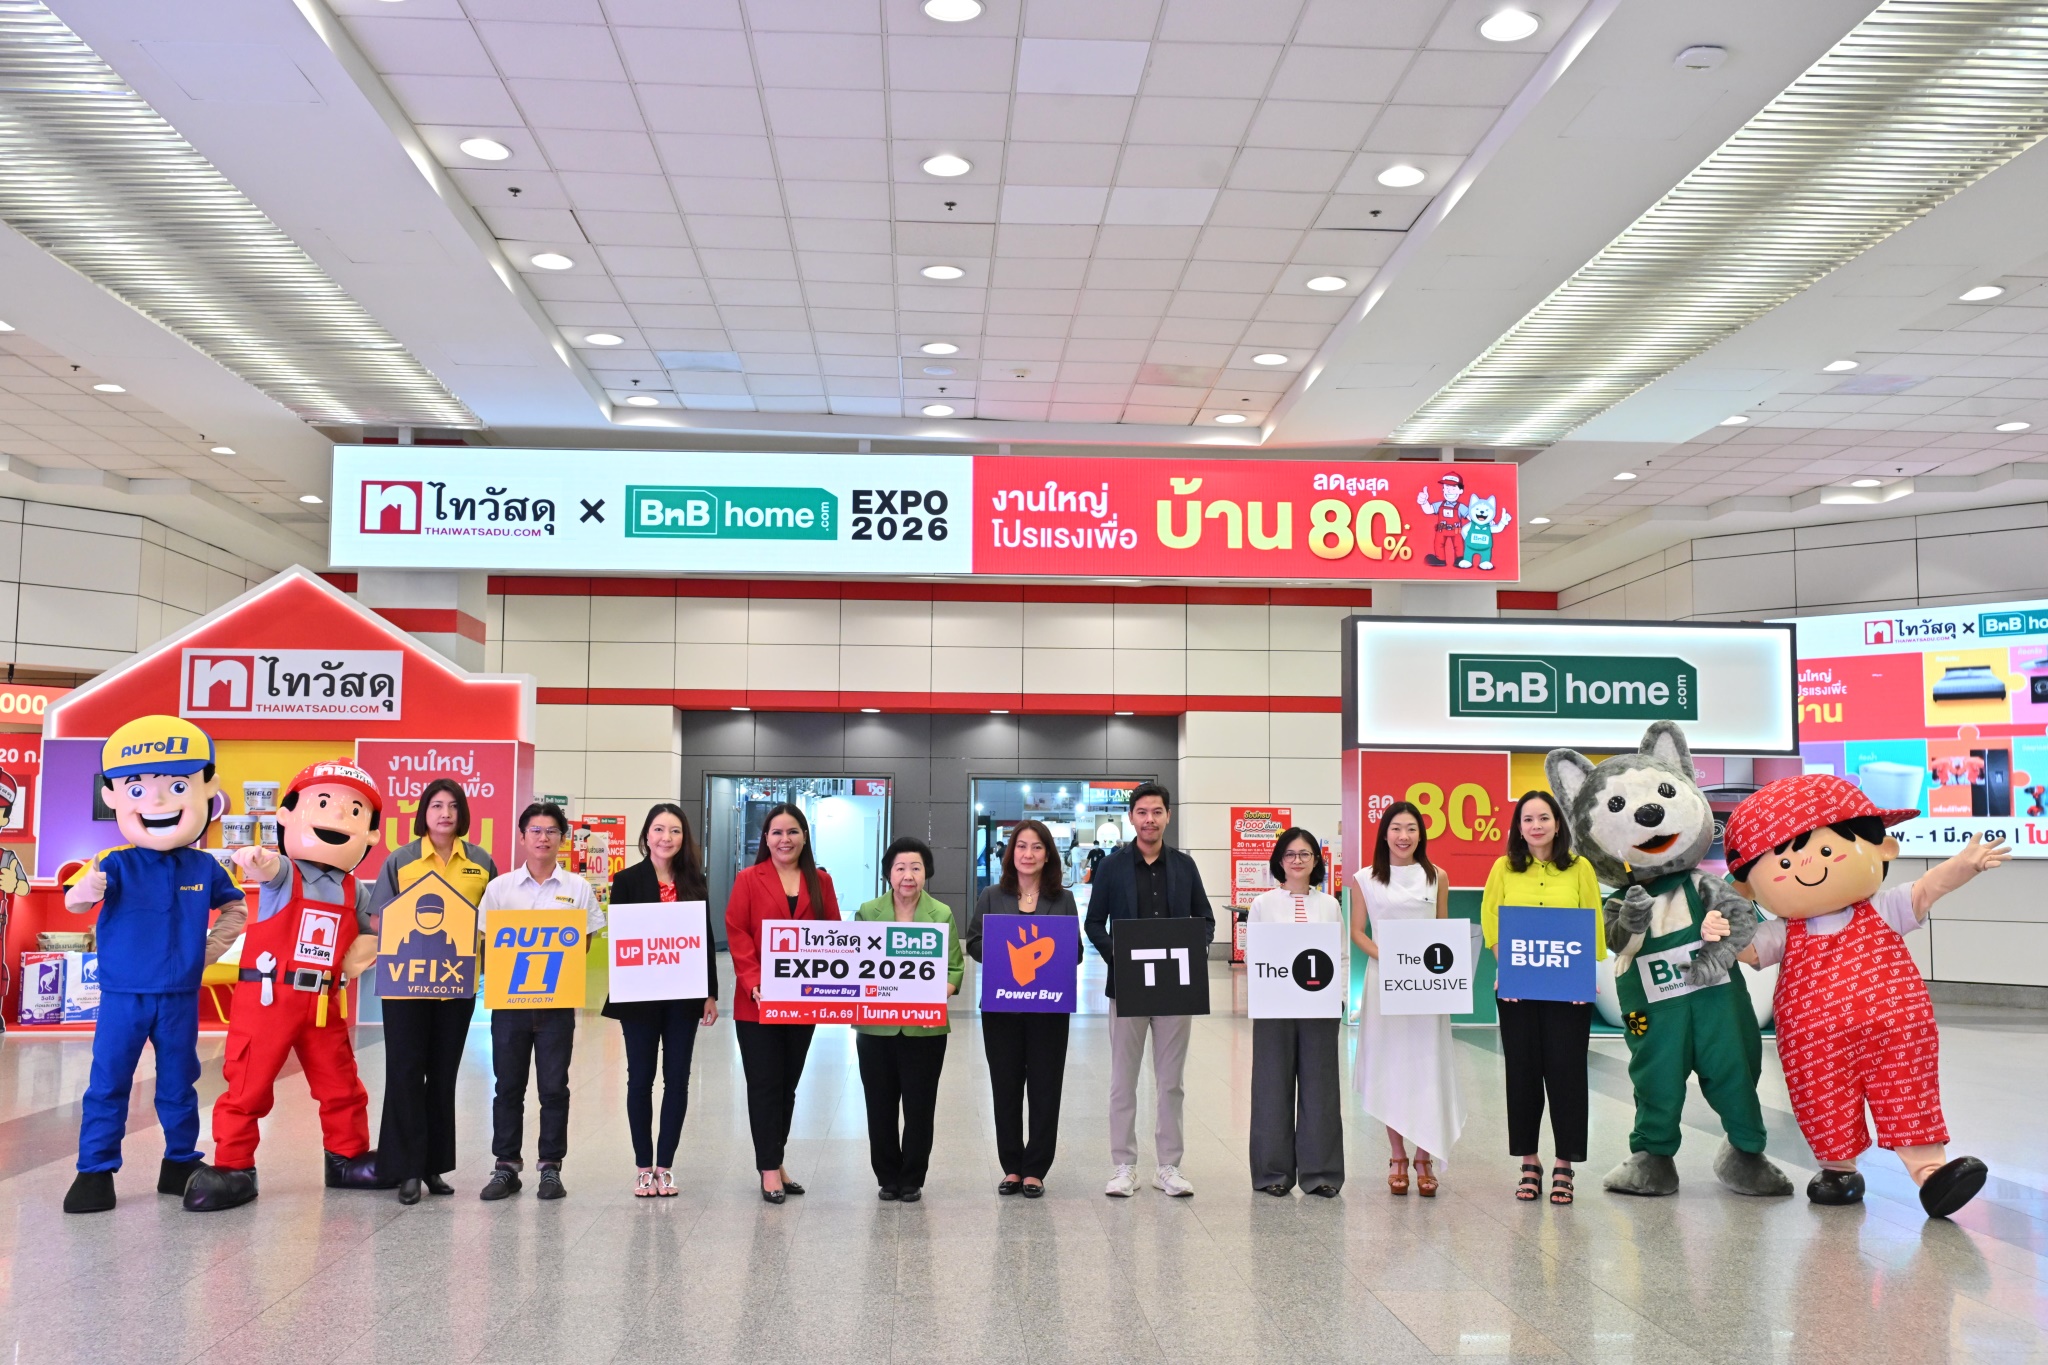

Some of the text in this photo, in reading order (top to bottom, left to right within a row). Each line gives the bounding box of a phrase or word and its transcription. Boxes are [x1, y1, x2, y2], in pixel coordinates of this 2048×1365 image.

[851, 490, 949, 516] EXPO
[991, 481, 1109, 518] งานใหญ่
[427, 480, 556, 535] ไทวัสดุ
[641, 500, 830, 531] BnB home .com
[1156, 477, 1292, 550] บ้าน
[425, 527, 541, 537] THAIWATSADU.COM
[851, 517, 949, 541] 2026
[991, 515, 1137, 550] โปรแรงเพื่อ
[1895, 619, 1956, 638] ไทวัสดุ
[1986, 617, 2022, 632] BnB
[259, 655, 394, 712] ไทวัสดุ
[1467, 671, 1687, 710] BnB home .com
[256, 704, 379, 714] THAIWATSADU.COM
[388, 749, 474, 775] งานใหญ่
[1765, 796, 1774, 804] UP
[1771, 797, 1786, 808] UNION
[1785, 799, 1795, 807] UP
[1791, 802, 1807, 813] UNION
[1805, 806, 1815, 815] UP
[1765, 812, 1775, 821] UP
[1786, 817, 1795, 827] UP
[1792, 815, 1819, 832] UNION PAN
[1766, 832, 1776, 841] UP
[494, 926, 579, 948] AUTO
[801, 927, 861, 953] ไทวัสดุ
[892, 931, 937, 950] BnB
[647, 936, 700, 951] UNION
[1511, 939, 1582, 955] BITEC
[1818, 942, 1828, 950] UP
[1854, 944, 1864, 952] UP
[619, 946, 640, 959] UP
[648, 952, 680, 965] PAN
[1397, 954, 1421, 965] The
[1511, 954, 1569, 968] BURI
[1832, 954, 1843, 962] UP
[1842, 956, 1859, 966] UNION
[1872, 955, 1882, 963] UP
[774, 959, 936, 981] EXPO 2026
[1255, 955, 1317, 978] The 1
[1811, 961, 1822, 969] UP
[1851, 963, 1862, 971] UP
[1828, 972, 1839, 981] UP
[1829, 974, 1859, 989] UNION PAN
[408, 985, 464, 994] VFIX.CO.TH
[813, 987, 857, 997] Power Buy
[866, 987, 877, 996] UP
[1847, 983, 1857, 991] UP
[996, 989, 1063, 1002] Power Buy
[1823, 992, 1834, 1000] UP
[766, 1010, 778, 1018] 20
[811, 1010, 816, 1018] 1
[863, 1005, 898, 1020] ไบเทค
[902, 1010, 941, 1020] บางนา
[1841, 1003, 1852, 1012] UP
[1866, 1007, 1877, 1016] UP
[1876, 1012, 1893, 1020] UNION
[1825, 1024, 1836, 1032] UP
[1895, 1052, 1905, 1060] UP
[1900, 1086, 1911, 1094] UP
[1893, 1105, 1904, 1113] UP
[1908, 1120, 1919, 1128] UP
